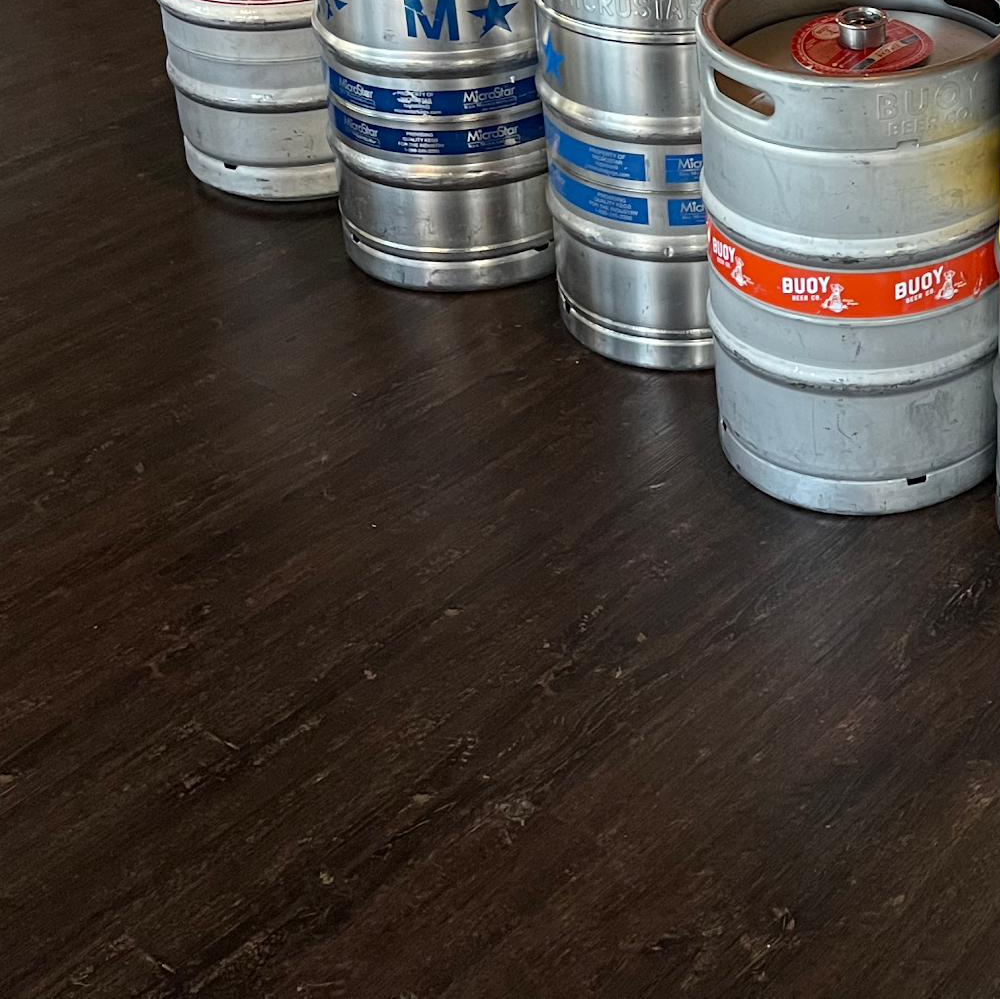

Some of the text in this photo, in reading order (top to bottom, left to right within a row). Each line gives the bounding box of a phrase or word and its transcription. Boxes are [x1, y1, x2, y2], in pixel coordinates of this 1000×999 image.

[462, 86, 516, 104] MicroStar
[876, 70, 980, 121] BUOY
[466, 125, 519, 143] MicroStar
[712, 236, 736, 263] BUOY
[781, 276, 831, 294] BUOY
[894, 265, 944, 300] BUOY
[905, 289, 936, 304] BEER CO.
